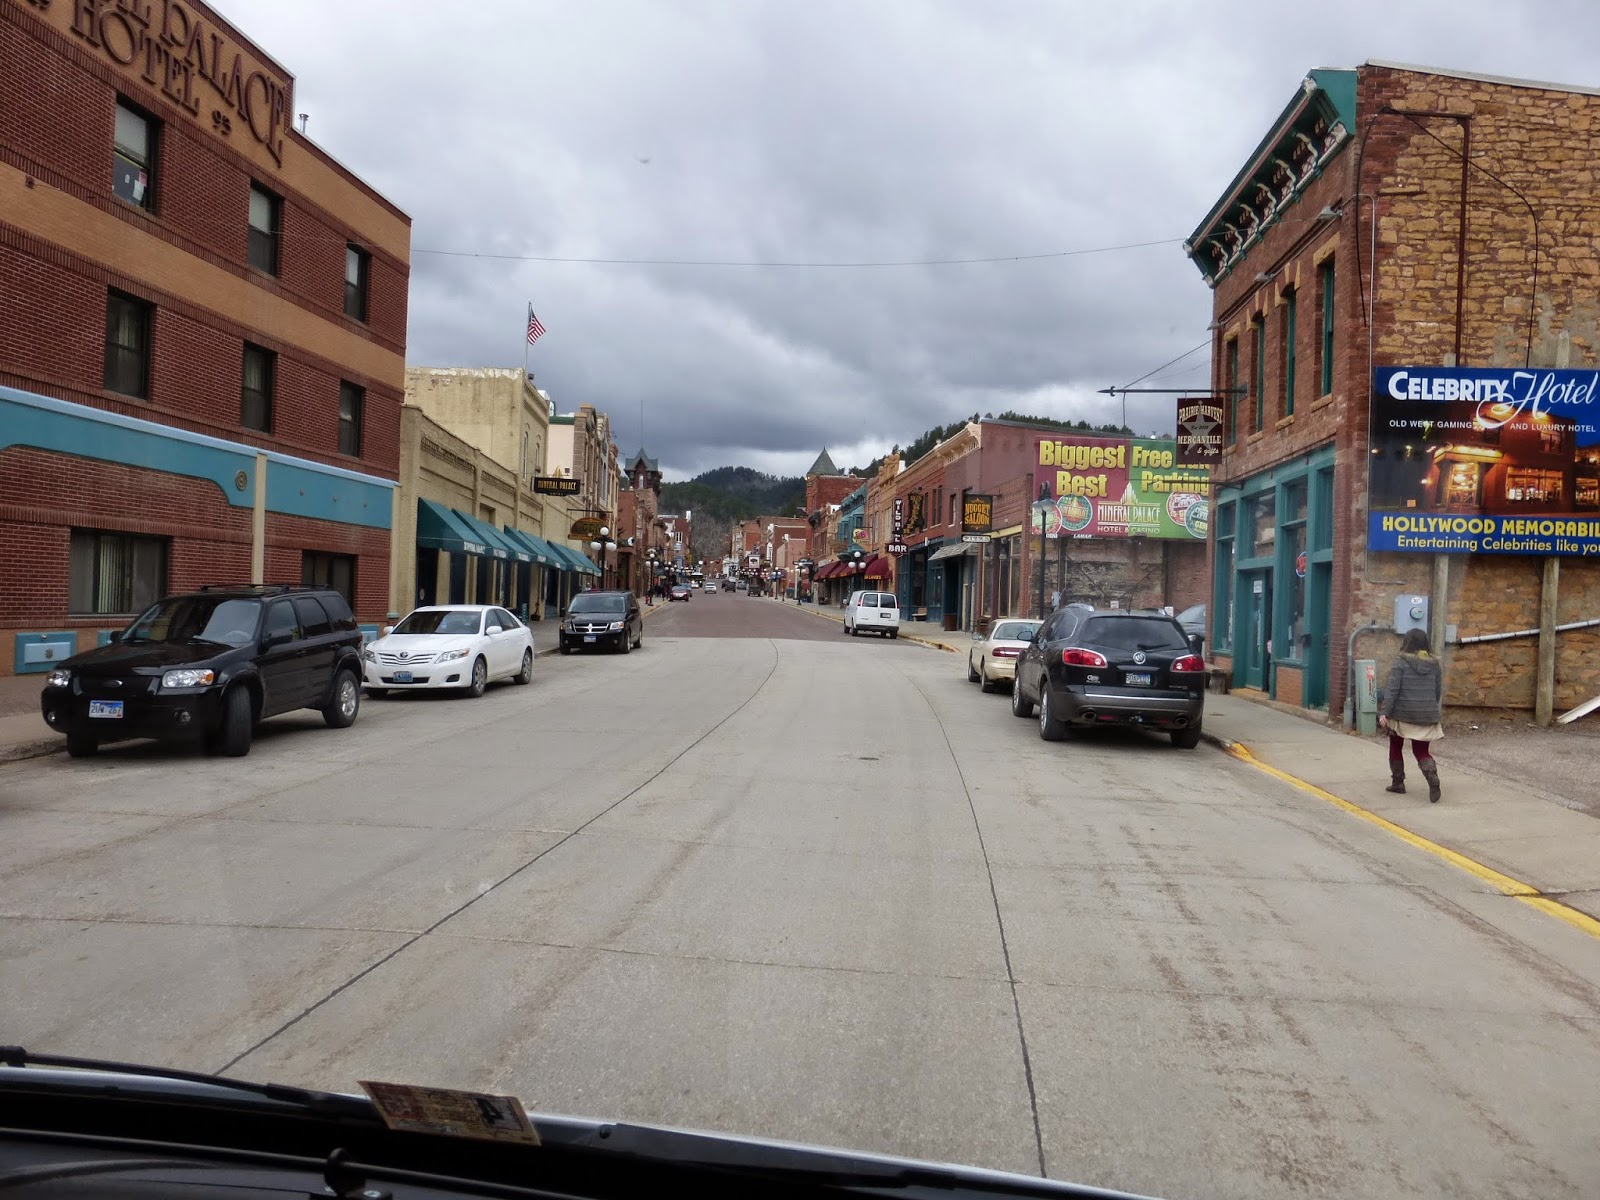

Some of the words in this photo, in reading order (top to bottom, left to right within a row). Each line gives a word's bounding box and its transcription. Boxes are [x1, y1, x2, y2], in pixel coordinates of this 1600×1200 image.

[70, 0, 201, 117] HOTEL
[160, 0, 286, 168] PALACE
[1388, 371, 1510, 402] CELEBRITY
[1476, 371, 1599, 429] Hotel
[1179, 405, 1199, 424] PRAIRIE
[1201, 405, 1222, 424] HARVEST
[1389, 420, 1407, 428] OLD
[1436, 421, 1473, 429] GAMING
[1509, 423, 1529, 431] AND
[1531, 424, 1566, 432] LUXURY
[1568, 425, 1597, 433] HOTEL
[1177, 435, 1222, 445] MERCANTILE
[1039, 440, 1126, 470] Biggest
[1132, 446, 1173, 469] Free
[1203, 447, 1219, 457] gifts
[1056, 471, 1107, 498] Best
[1141, 470, 1210, 497] Parking
[965, 503, 990, 516] NUGGET
[1097, 504, 1130, 522] MINERAL
[1132, 506, 1161, 523] PALACE
[965, 513, 990, 525] SALOON
[1382, 516, 1496, 534] HOLLYWOOD
[1501, 519, 1600, 538] MEMORABIL
[1097, 525, 1122, 533] HOTEL
[1130, 527, 1160, 535] CASINO
[888, 544, 908, 553] BAR
[1397, 535, 1478, 551] Entertaining
[1482, 537, 1552, 551] Celebrities
[1556, 539, 1579, 552] like
